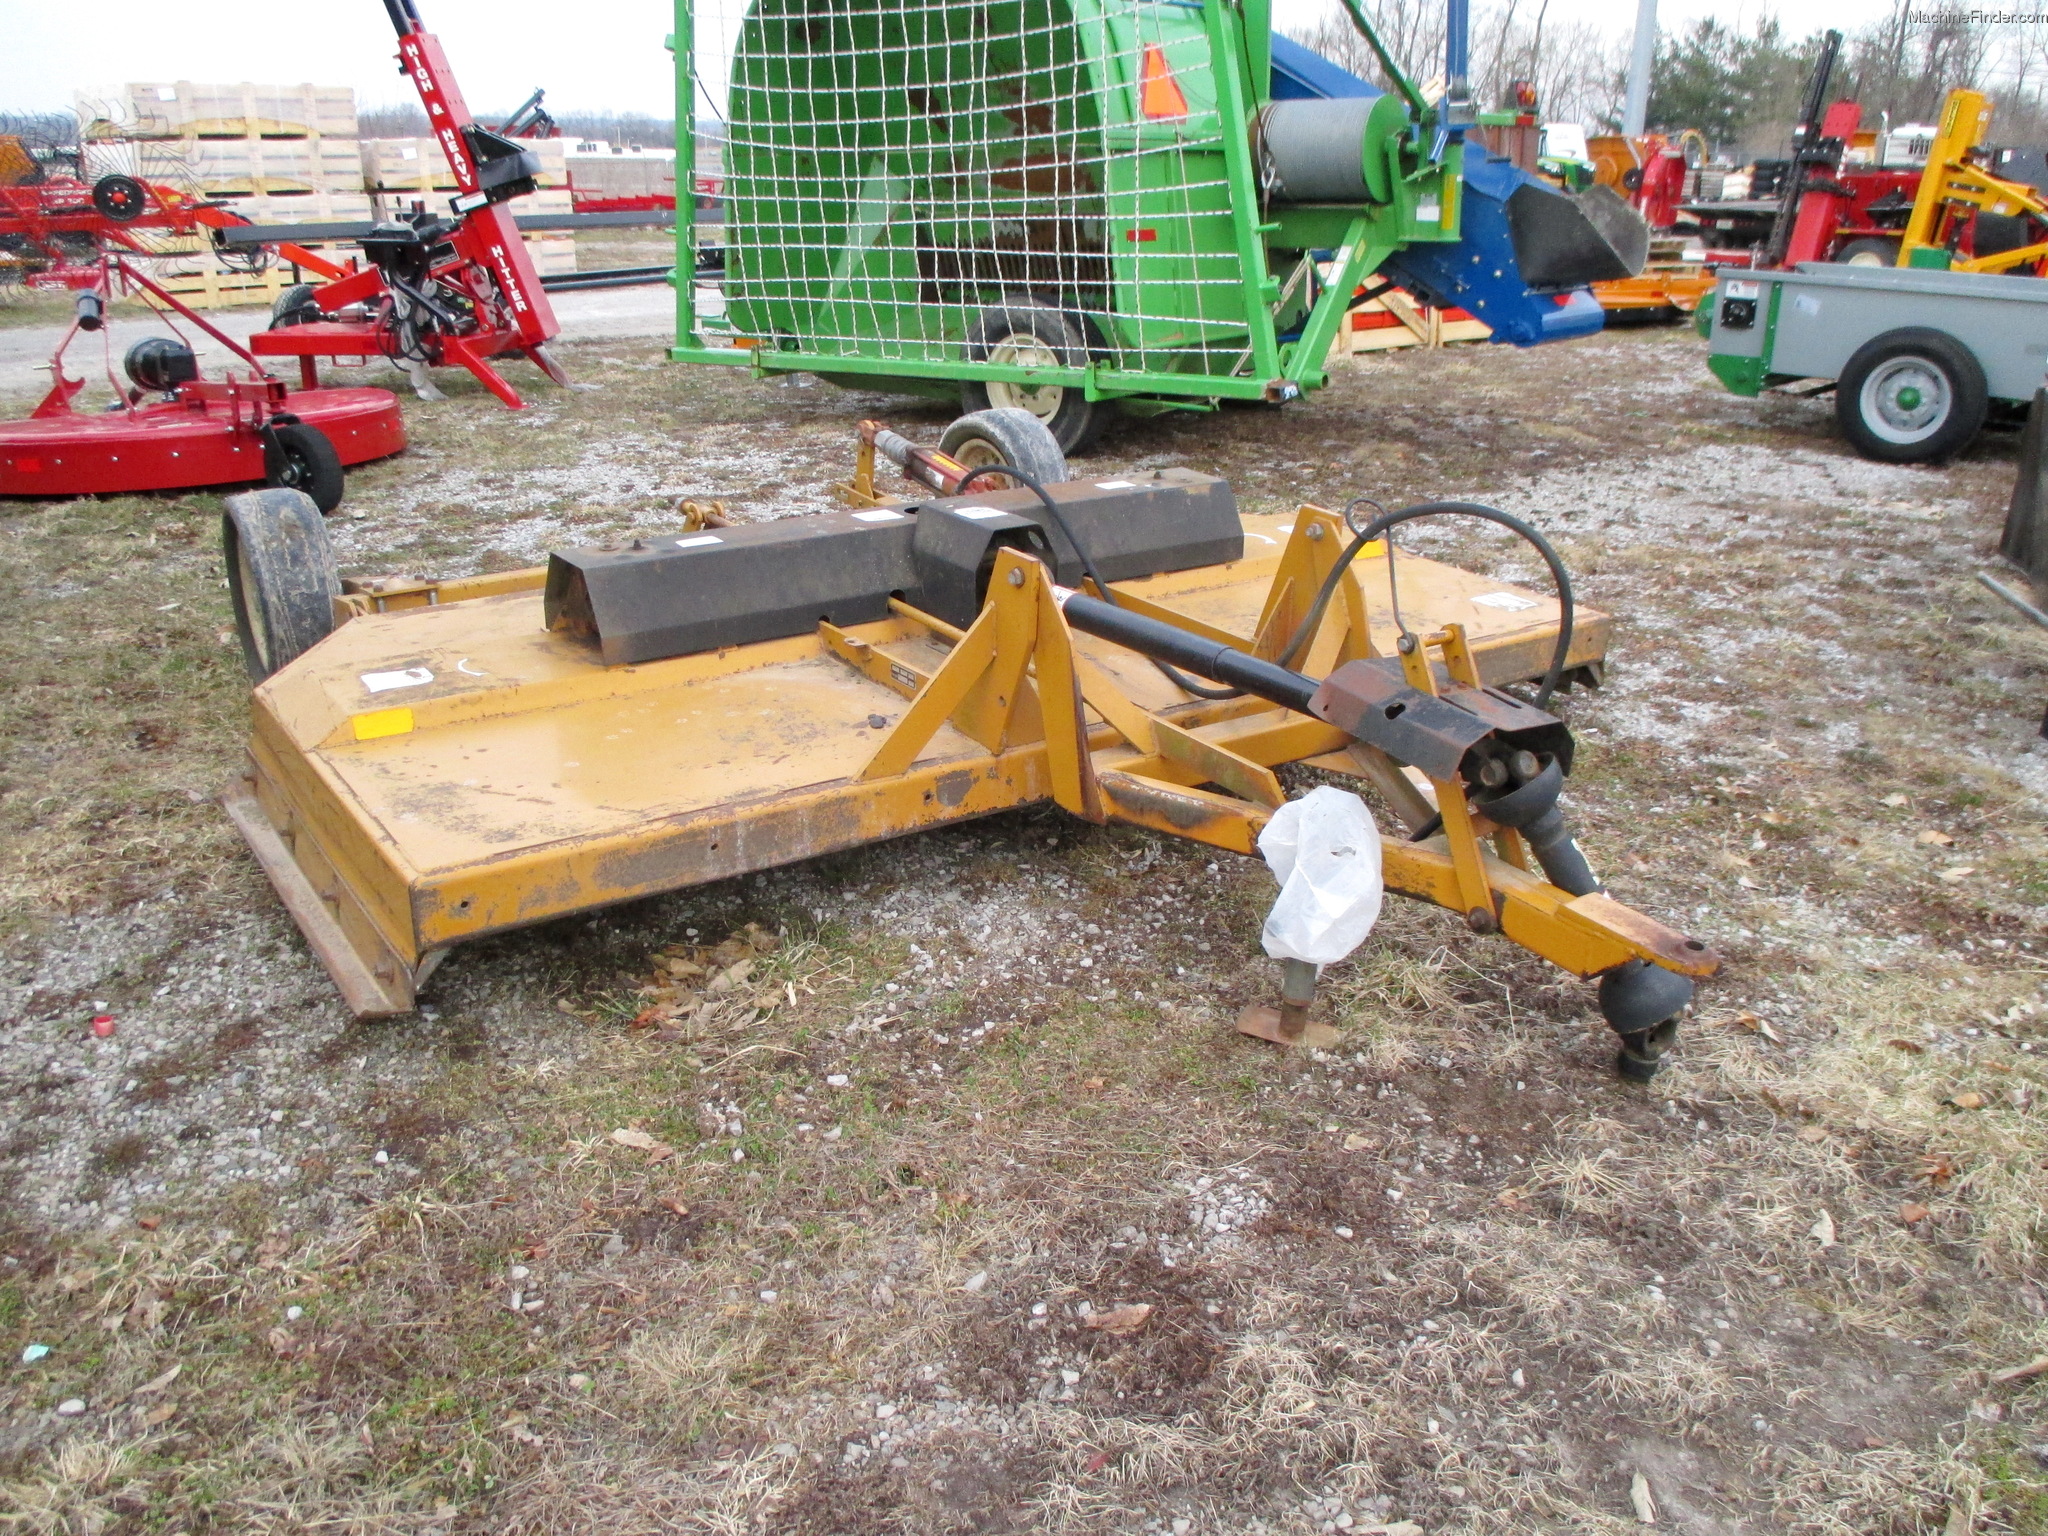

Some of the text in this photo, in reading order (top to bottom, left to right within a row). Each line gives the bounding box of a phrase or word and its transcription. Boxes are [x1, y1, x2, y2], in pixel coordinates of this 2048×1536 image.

[405, 43, 528, 313] HIGH & HEAVY HITTER
